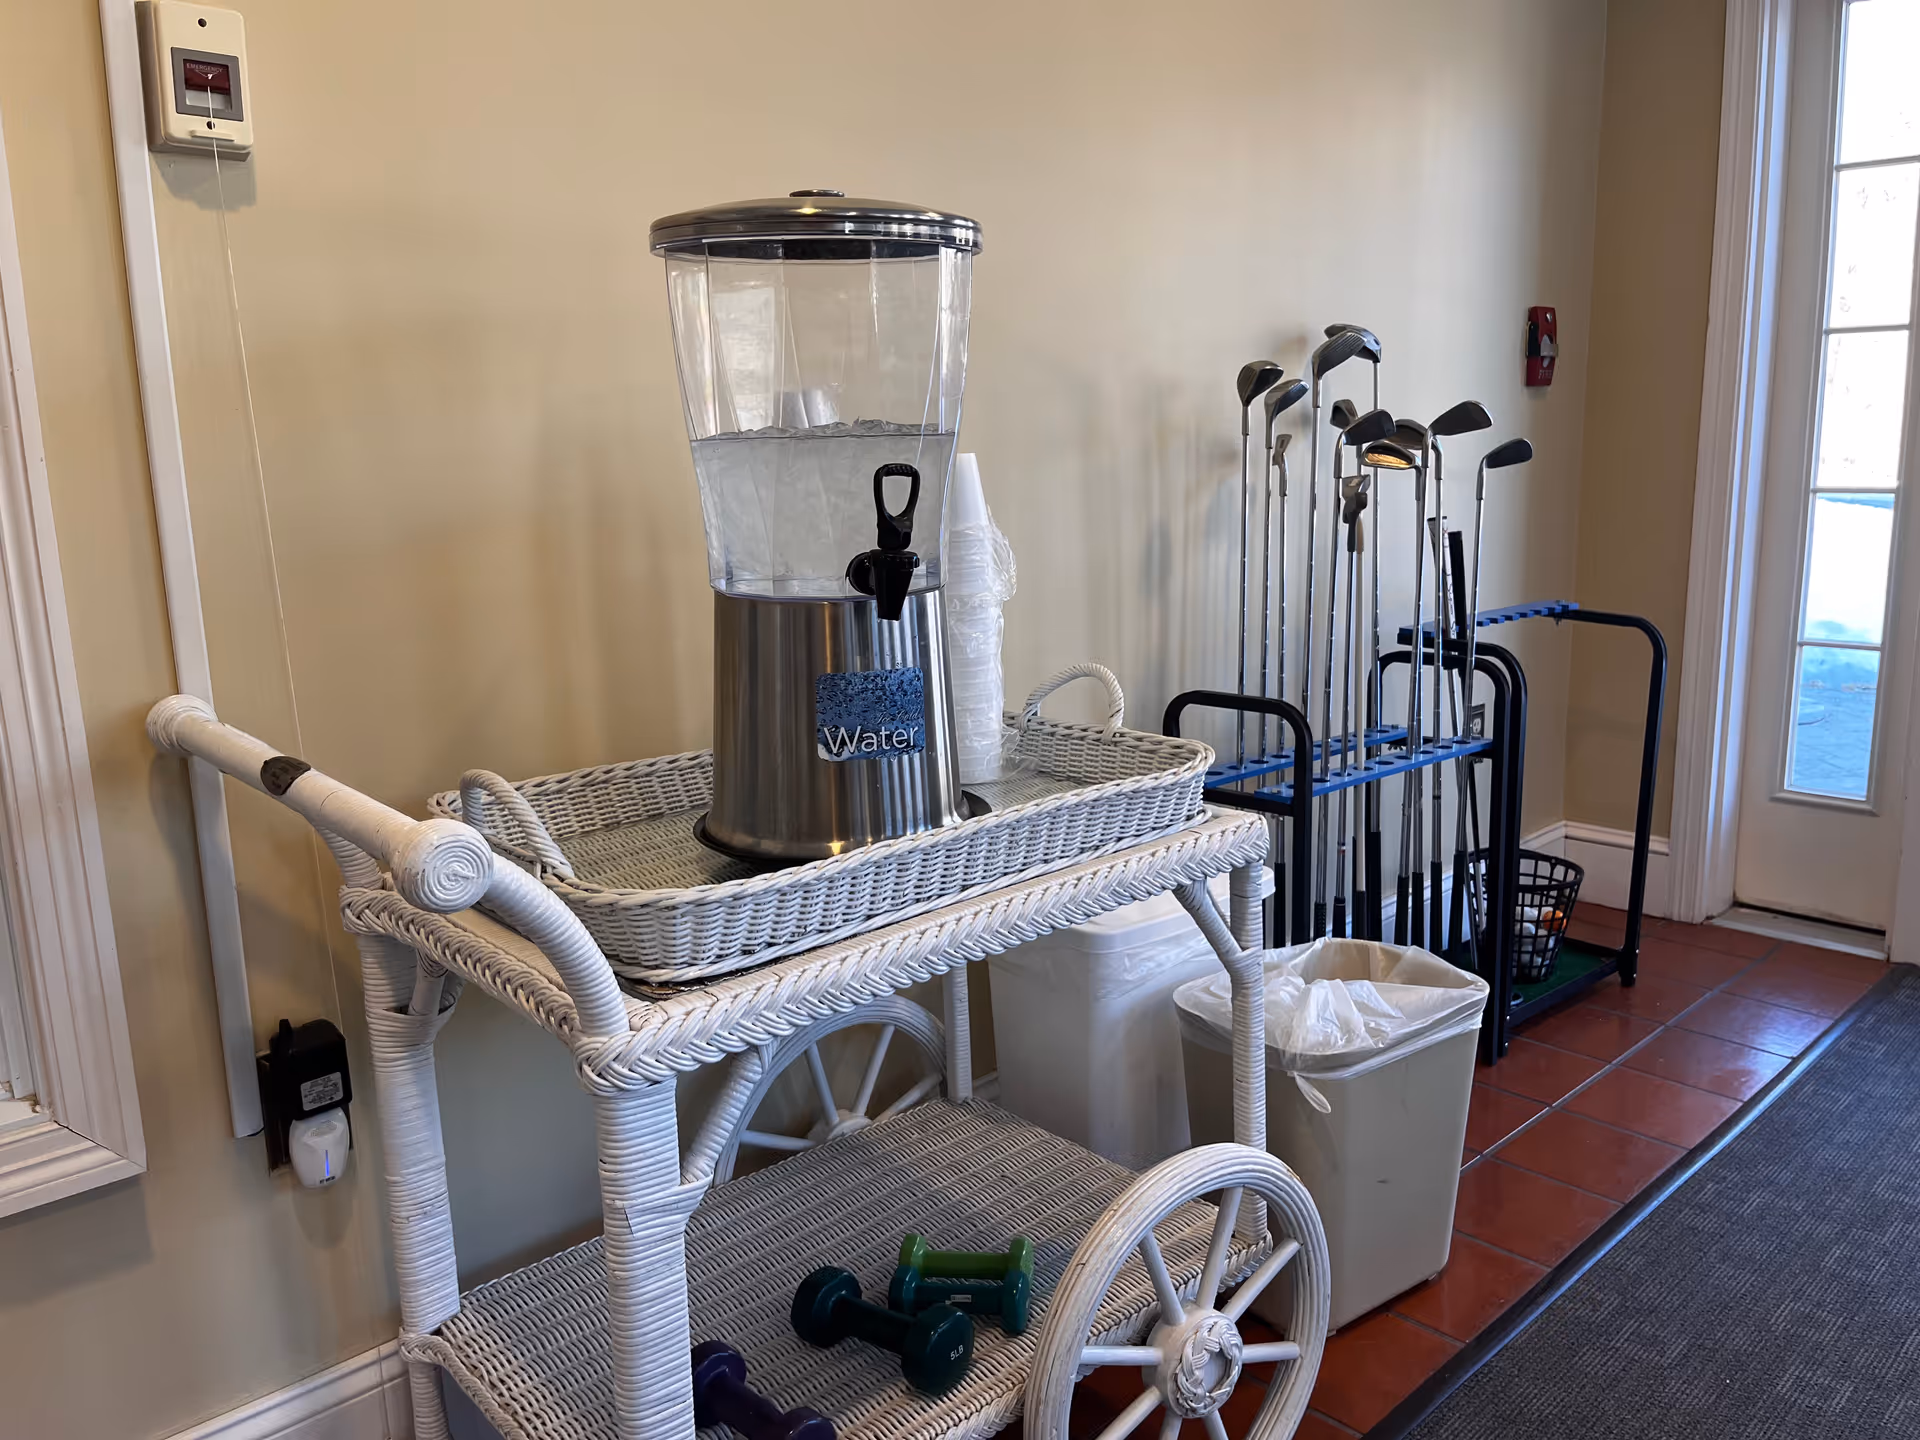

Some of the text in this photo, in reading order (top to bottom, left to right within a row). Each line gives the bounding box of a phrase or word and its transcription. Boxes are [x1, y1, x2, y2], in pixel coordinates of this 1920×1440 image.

[186, 63, 223, 73] EMERGENCY
[823, 725, 919, 754] Water
[950, 1344, 964, 1361] 5LB
